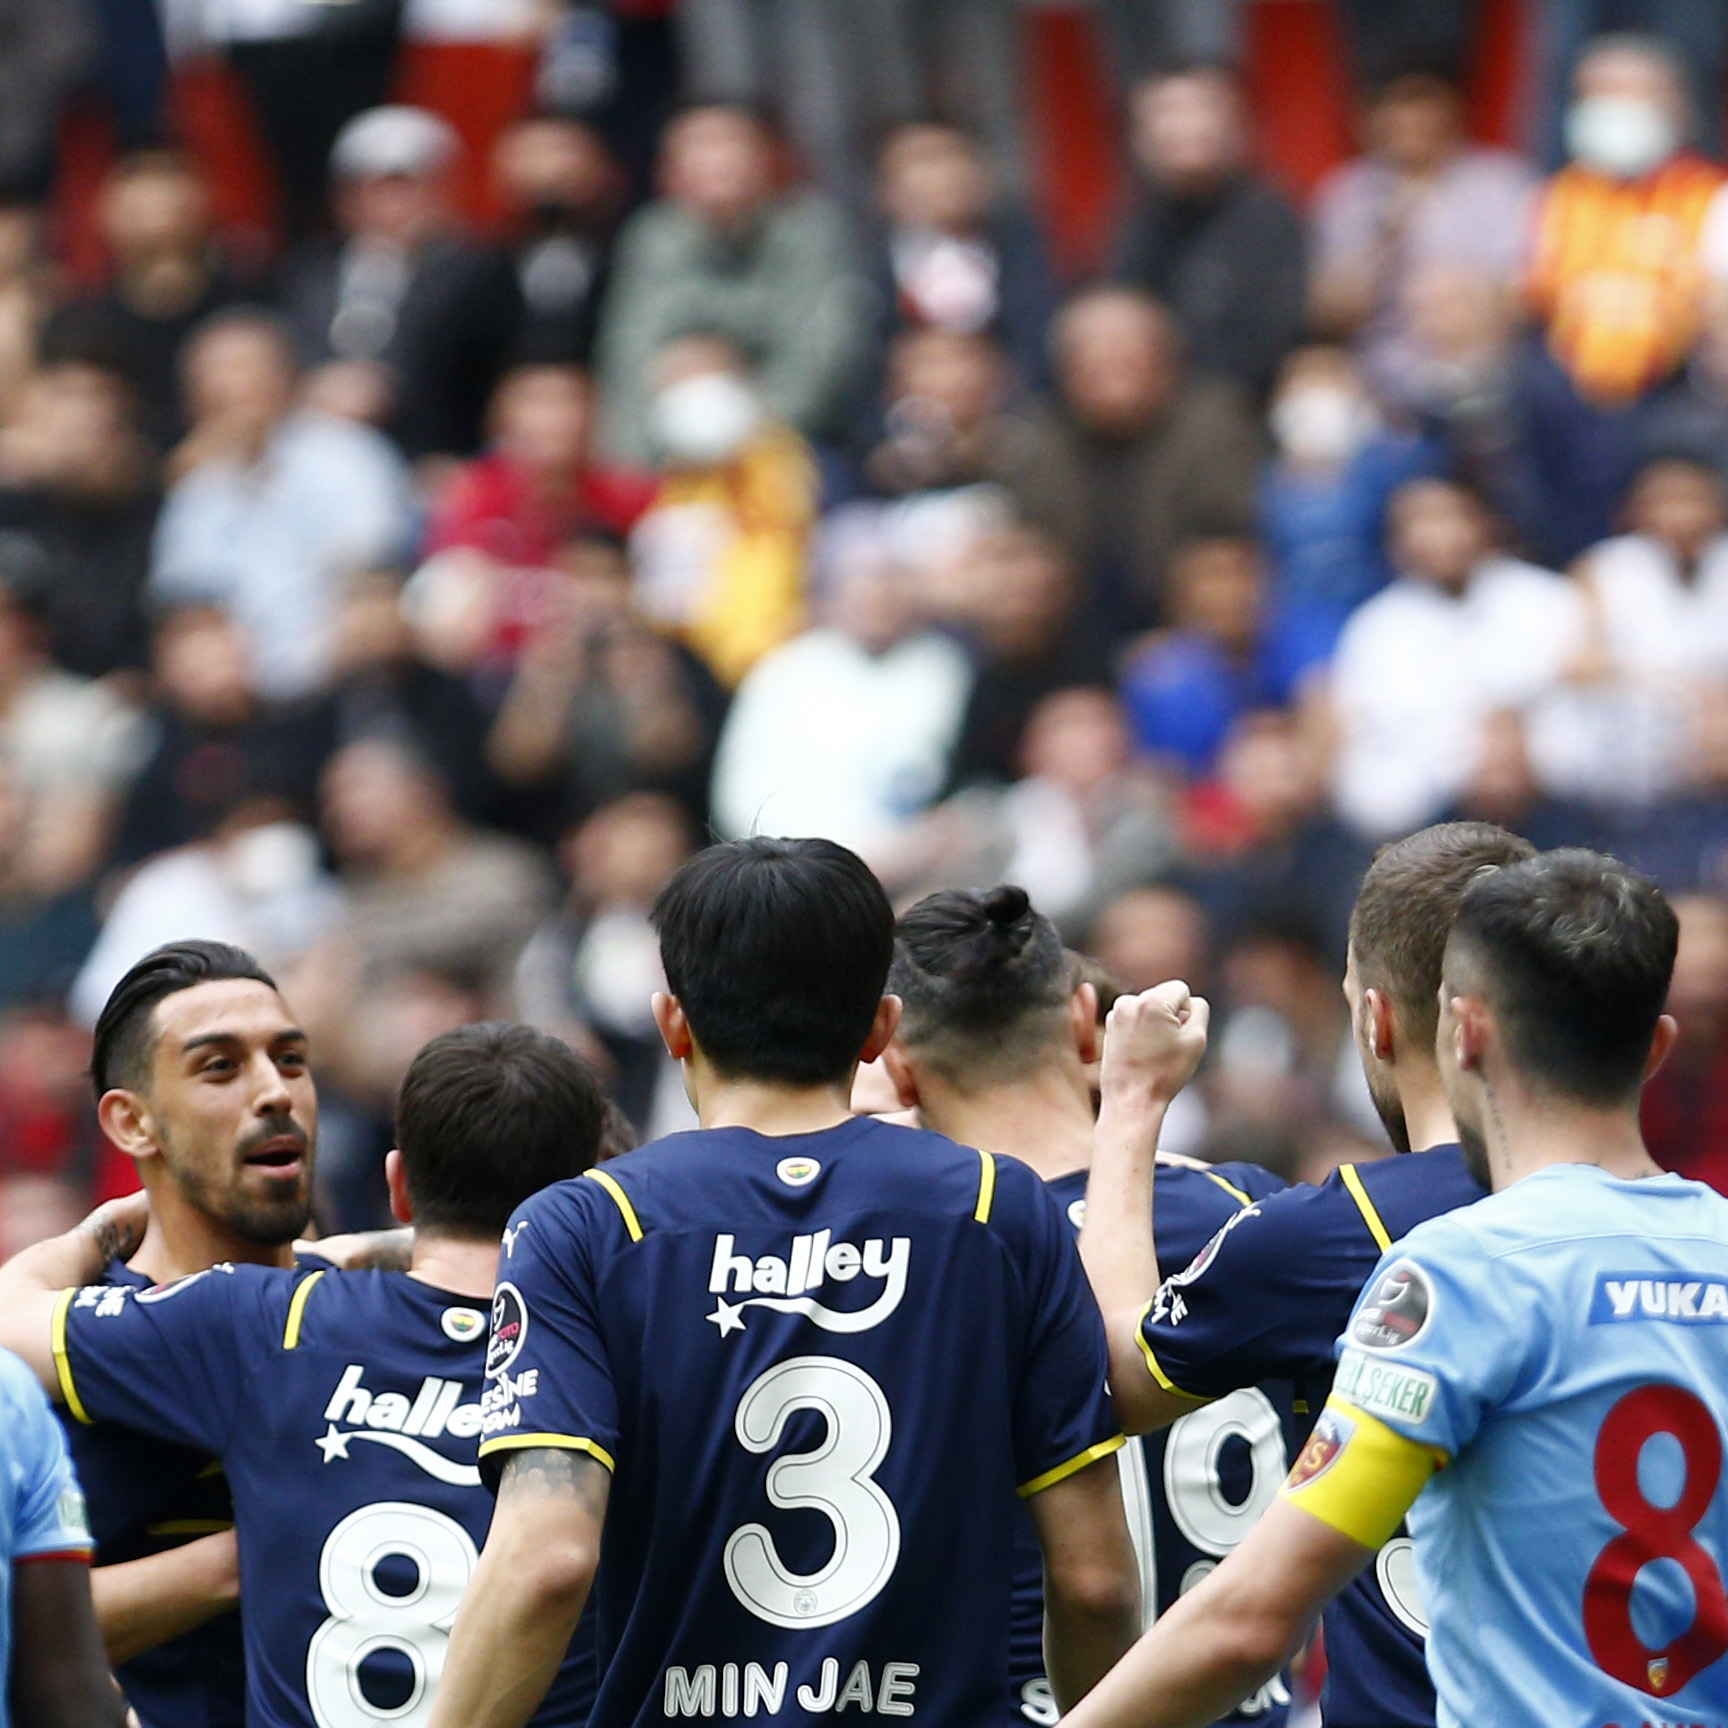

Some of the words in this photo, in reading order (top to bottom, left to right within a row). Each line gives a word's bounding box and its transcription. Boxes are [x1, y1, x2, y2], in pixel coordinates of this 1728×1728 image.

[706, 1228, 912, 1334] halley
[723, 1355, 901, 1631] 3
[663, 1660, 789, 1719] MIN
[796, 1657, 921, 1719] JAE
